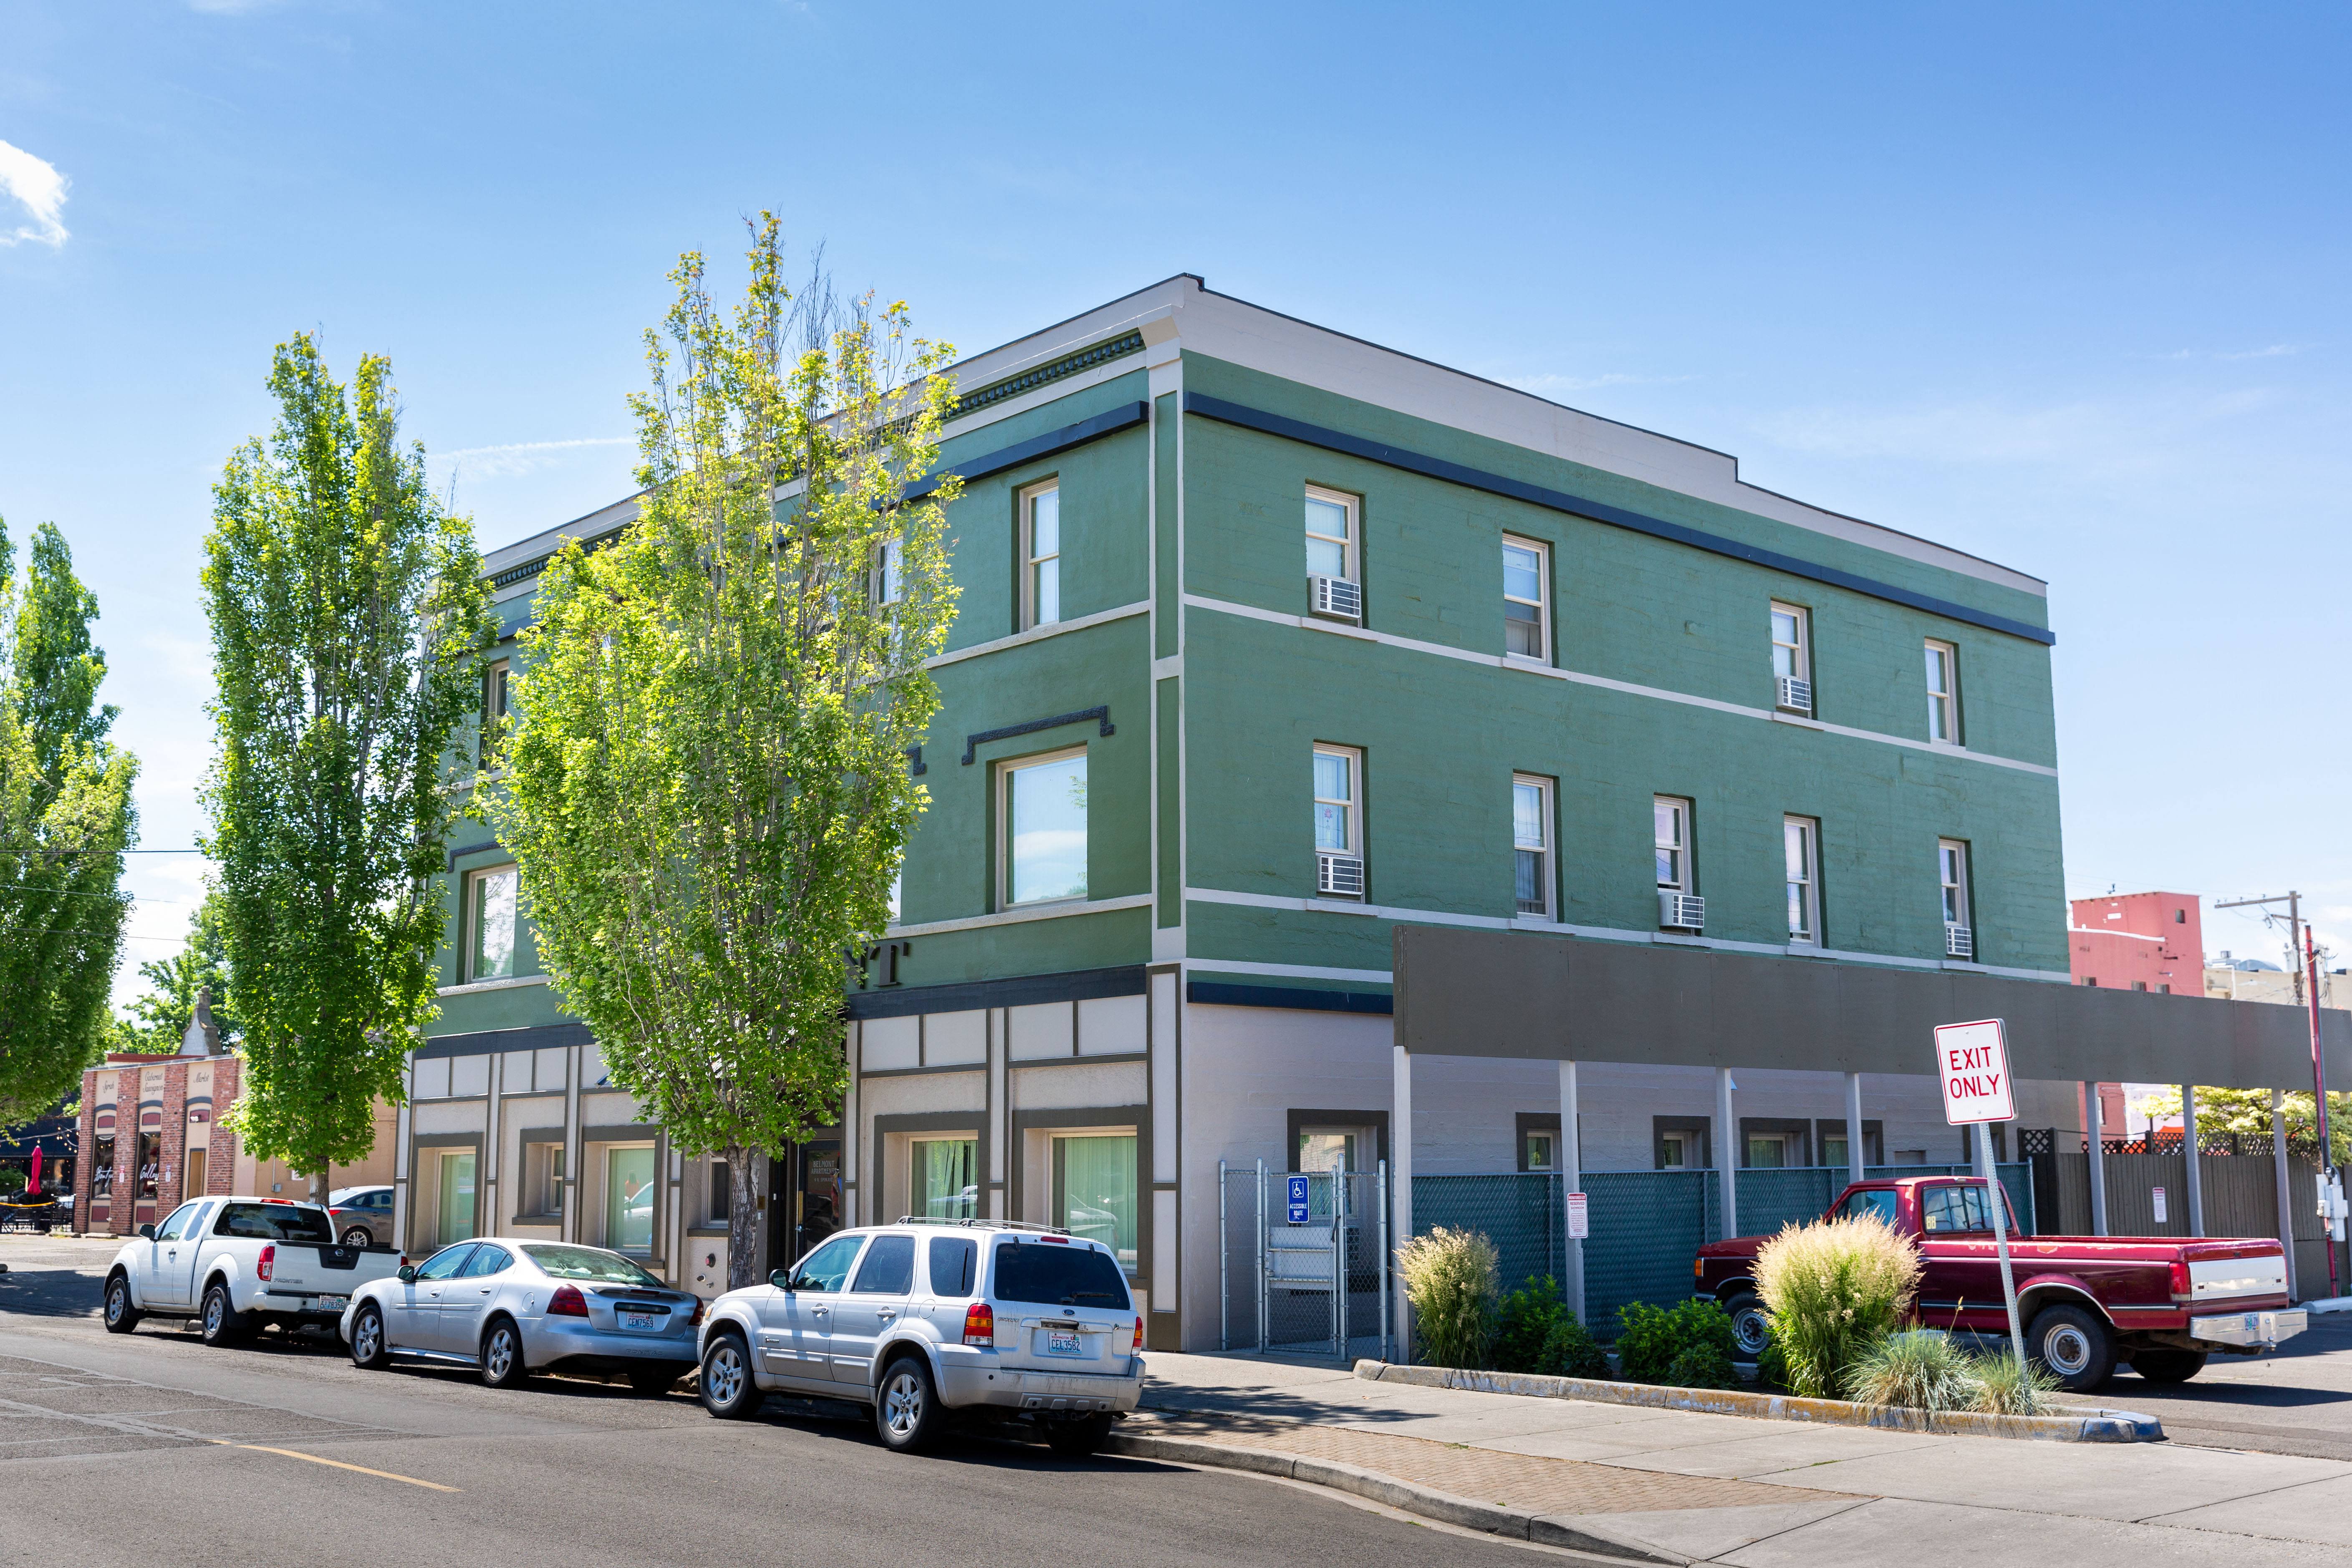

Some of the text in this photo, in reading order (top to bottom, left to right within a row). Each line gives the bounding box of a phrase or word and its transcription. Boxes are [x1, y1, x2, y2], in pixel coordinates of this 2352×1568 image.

[1949, 1046, 1991, 1071] EXIT
[145, 1071, 163, 1081] Cabernet
[193, 1072, 209, 1083] Merlot
[102, 1080, 114, 1094] Syrah
[143, 1082, 163, 1095] Sauvignon
[1950, 1074, 1999, 1099] ONLY
[628, 1318, 654, 1328] CEN7569
[1052, 1339, 1080, 1351] CEL3582
